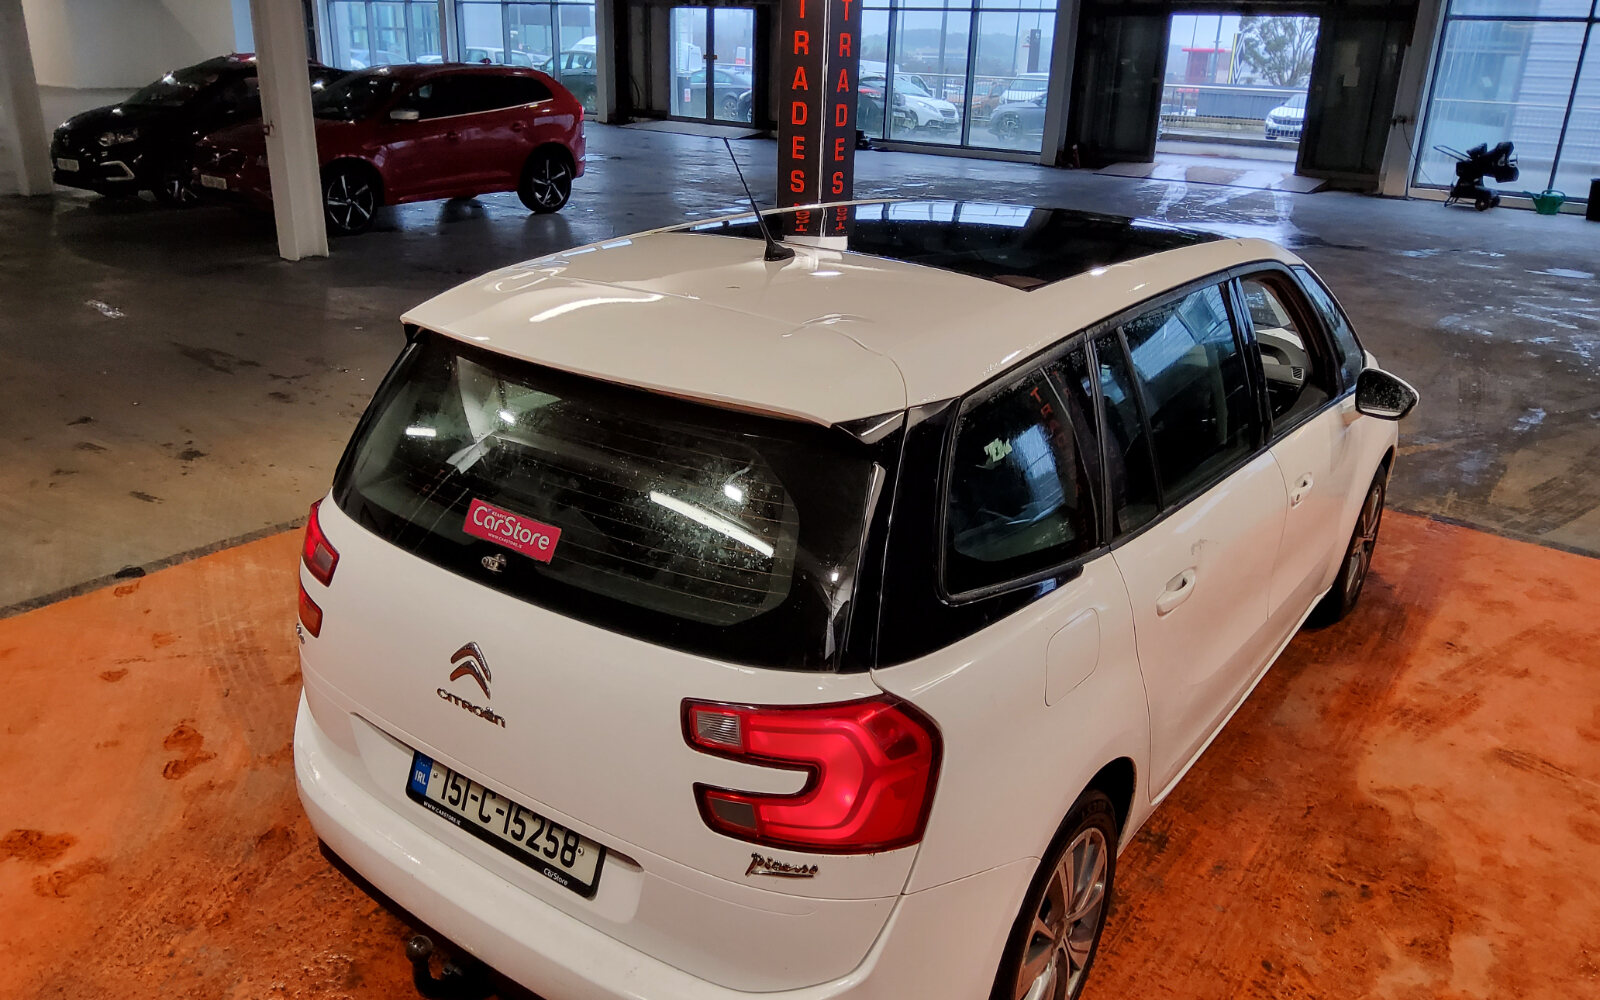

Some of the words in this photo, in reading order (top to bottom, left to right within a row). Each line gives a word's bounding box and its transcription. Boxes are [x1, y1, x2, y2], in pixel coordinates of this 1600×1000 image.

[831, 0, 852, 195] TRADES
[473, 506, 550, 550] CarStore
[414, 769, 427, 786] IRL
[543, 867, 569, 886] CarStore
